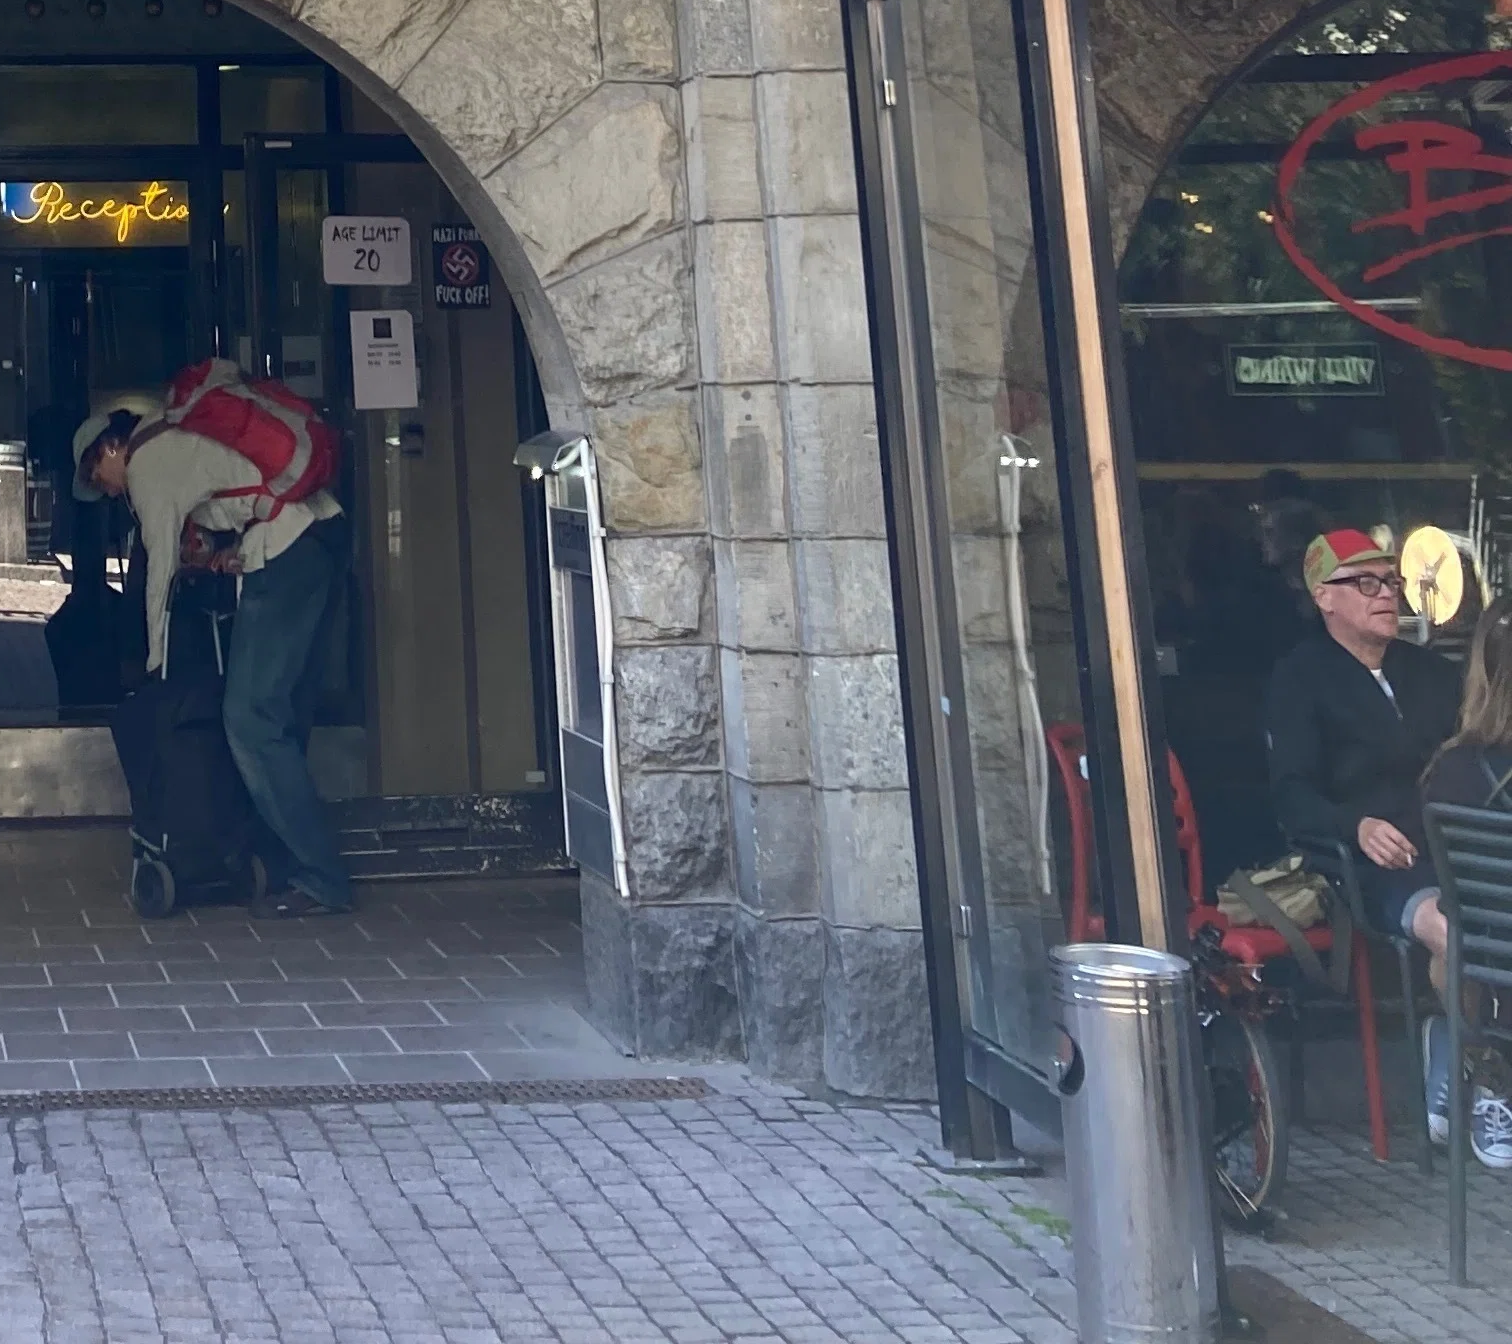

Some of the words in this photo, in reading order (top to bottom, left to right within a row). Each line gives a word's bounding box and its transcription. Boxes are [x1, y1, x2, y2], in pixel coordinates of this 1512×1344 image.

[11, 181, 230, 243] Receptio
[332, 225, 357, 242] AGE
[362, 225, 402, 243] LIMIT
[433, 227, 457, 243] NAZI
[354, 247, 380, 272] 20
[436, 284, 463, 304] FUCK
[464, 284, 489, 305] OFF!
